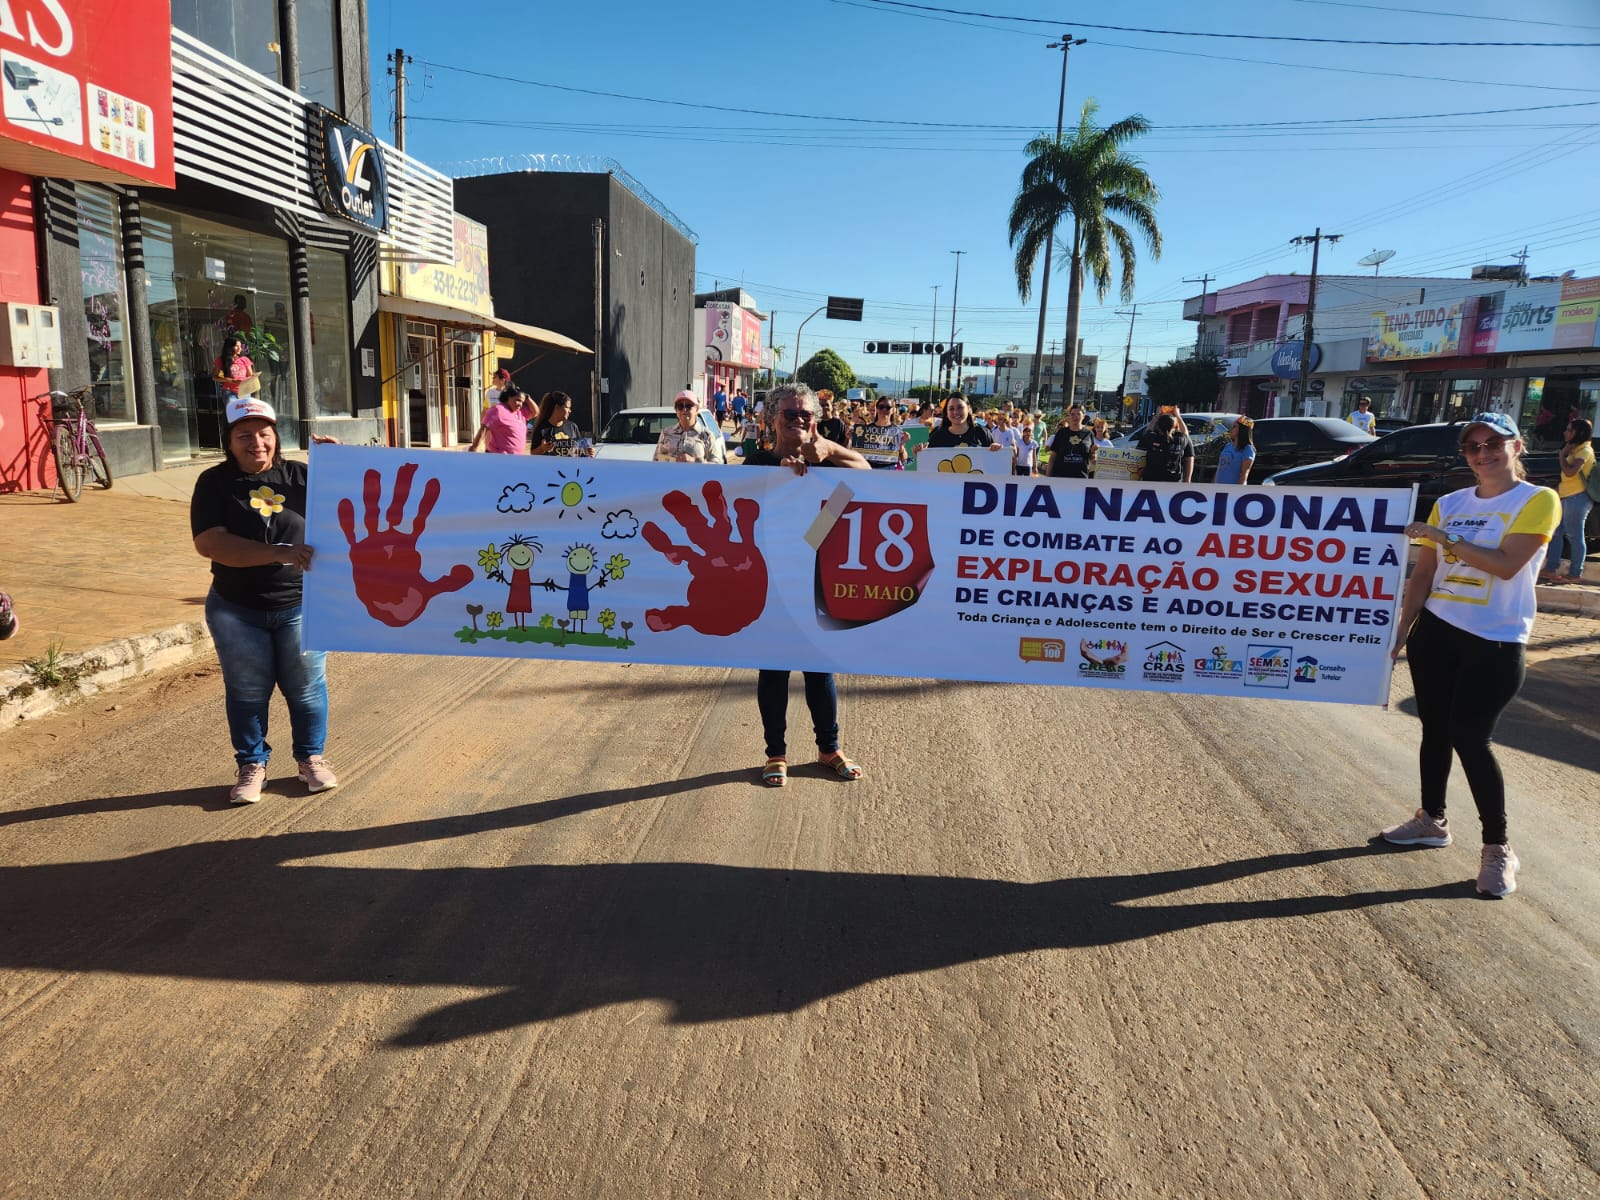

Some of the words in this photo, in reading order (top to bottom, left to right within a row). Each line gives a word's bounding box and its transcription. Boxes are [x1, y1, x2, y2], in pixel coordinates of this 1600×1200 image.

[341, 185, 374, 219] Outlet
[1384, 307, 1446, 334] TEND-TUDO
[1502, 305, 1556, 334] sports
[962, 481, 1061, 518] DIA
[1082, 486, 1405, 534] NACIONAL
[838, 507, 914, 573] 18
[960, 528, 994, 546] DE
[1003, 530, 1135, 552] COMBATE
[1143, 537, 1182, 555] AO
[1196, 532, 1346, 563] ABUSO
[1352, 547, 1371, 565] E
[1378, 543, 1399, 566] À
[957, 555, 1219, 594] EXPLORAÇÃO
[1233, 569, 1394, 601] SEXUAL
[833, 583, 859, 599] DE
[863, 584, 915, 601] MAIO
[955, 587, 989, 604] DE
[997, 589, 1133, 613] CRIANÇAS
[1142, 597, 1158, 613] E
[1166, 598, 1390, 626] ADOLESCENTES
[957, 612, 987, 622] Toda
[991, 613, 1040, 626] Criança
[1044, 618, 1052, 626] e
[1056, 616, 1136, 631] Adolescente
[1141, 623, 1165, 632] tem
[1170, 625, 1178, 633] o
[1182, 624, 1227, 636] Direito
[1231, 627, 1247, 637] de
[1252, 628, 1274, 638] Ser
[1291, 630, 1345, 642] Crescer
[1349, 633, 1381, 644] Feliz
[1044, 648, 1060, 659] 100
[1194, 658, 1243, 673] CMDCA
[1249, 656, 1289, 668] SEMAS
[1078, 662, 1126, 673] CREAS
[1143, 662, 1185, 673] CRAS
[1319, 664, 1346, 673] Conselho
[1321, 673, 1342, 681] Tutelar
